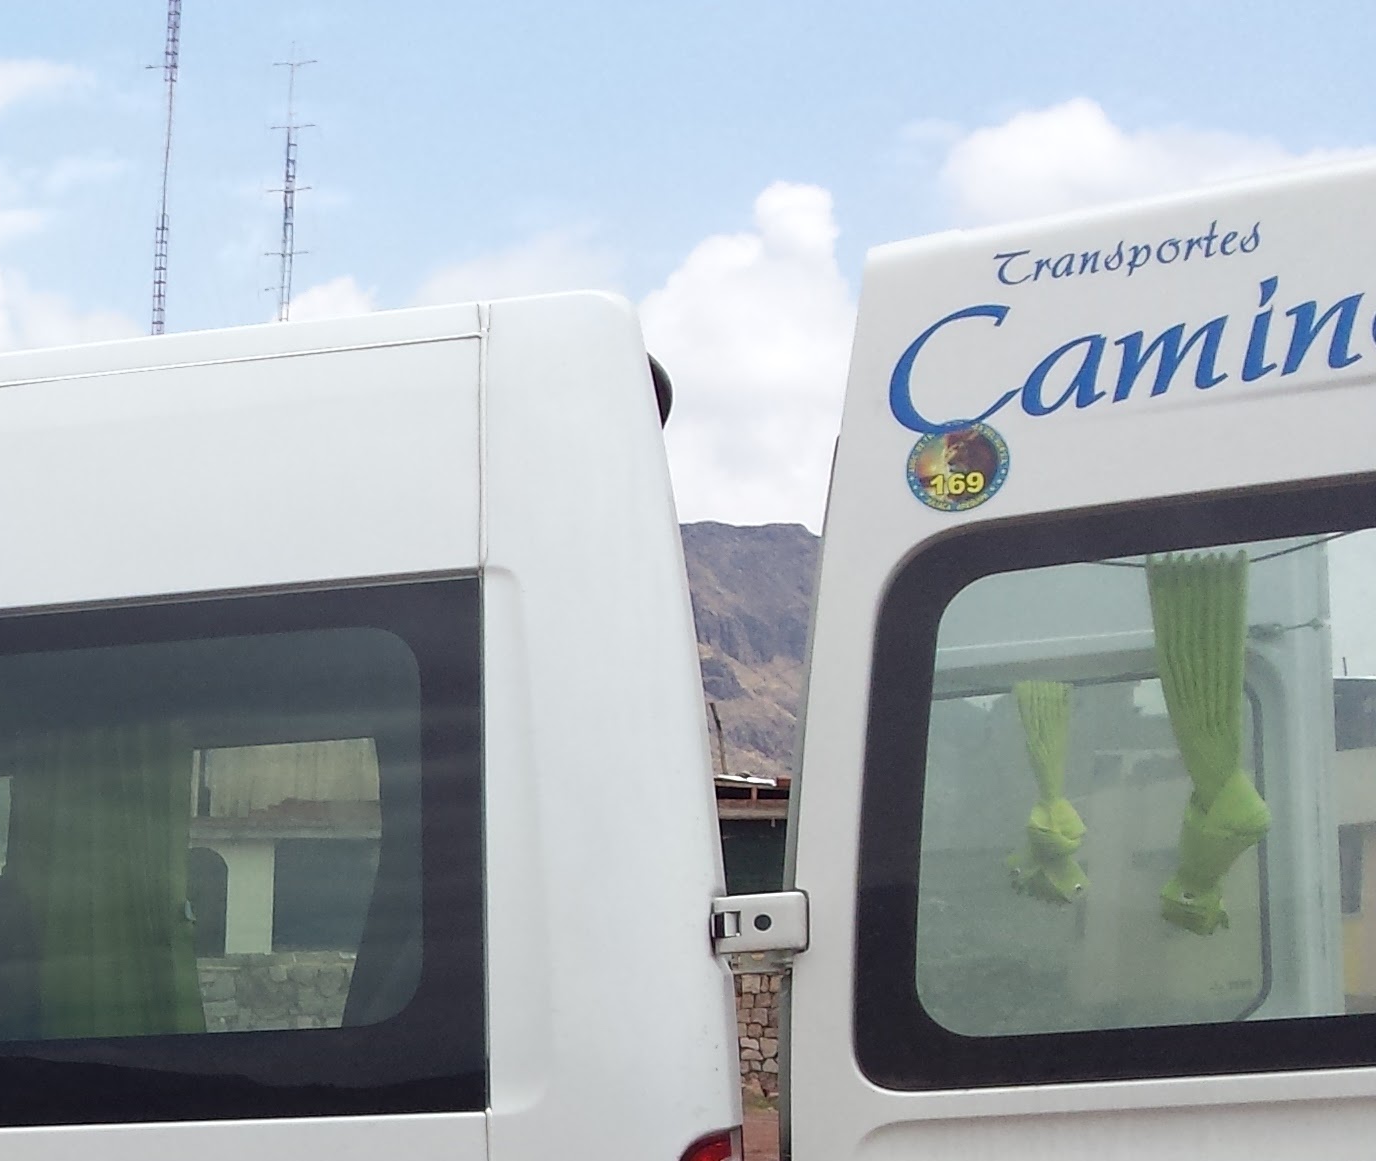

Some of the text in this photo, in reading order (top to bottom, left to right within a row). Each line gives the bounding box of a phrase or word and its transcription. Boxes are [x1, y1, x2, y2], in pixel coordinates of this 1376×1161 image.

[993, 220, 1262, 286] Transportes
[888, 275, 1376, 434] Camin
[929, 471, 985, 495] 169
